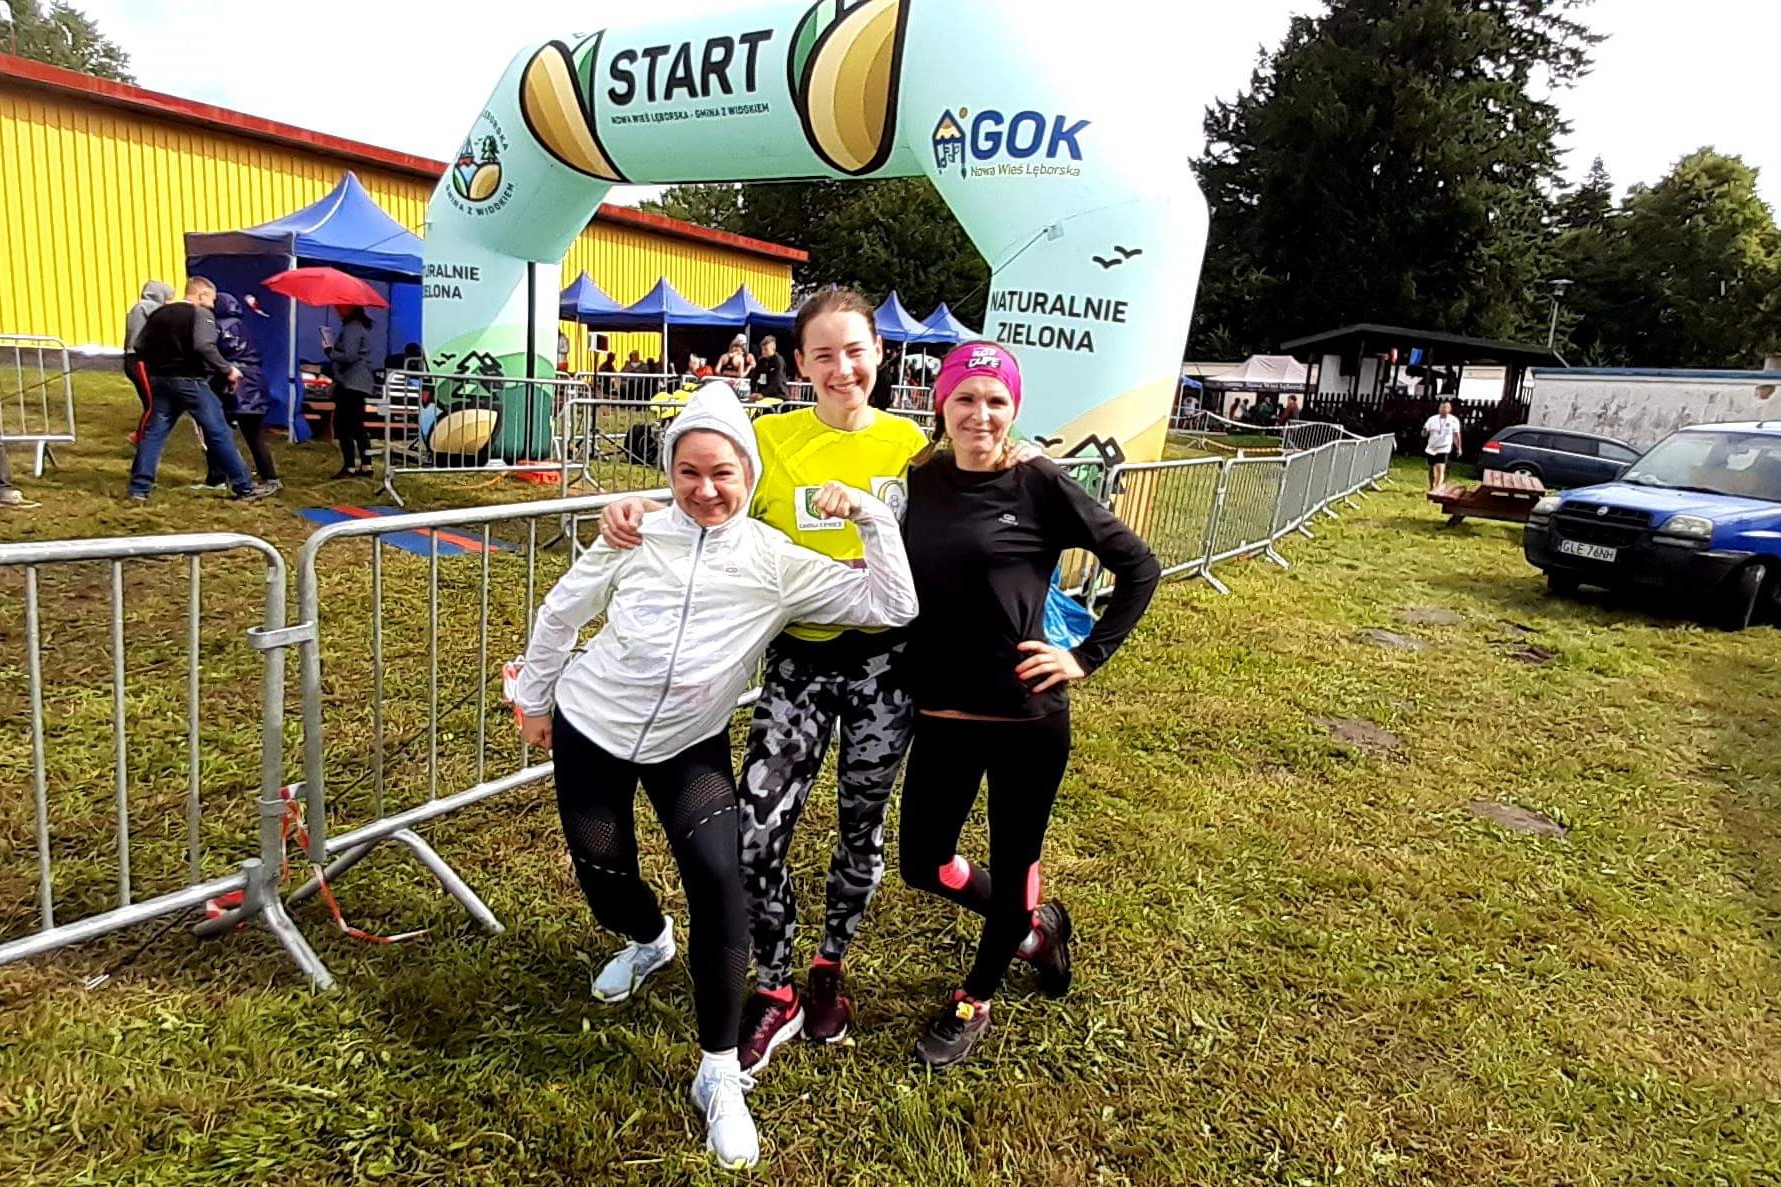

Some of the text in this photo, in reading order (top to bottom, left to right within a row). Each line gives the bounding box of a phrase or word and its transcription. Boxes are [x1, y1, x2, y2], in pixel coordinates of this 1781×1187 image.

[608, 29, 774, 106] START
[611, 115, 631, 125] NOWA
[721, 107, 727, 117] Z
[970, 110, 1092, 161] GOK
[970, 163, 1081, 178] Nowa Wieś Lęborska
[424, 283, 463, 300] ELONA
[990, 290, 1129, 323] NATURALNIE
[996, 321, 1095, 353] ZIELONA
